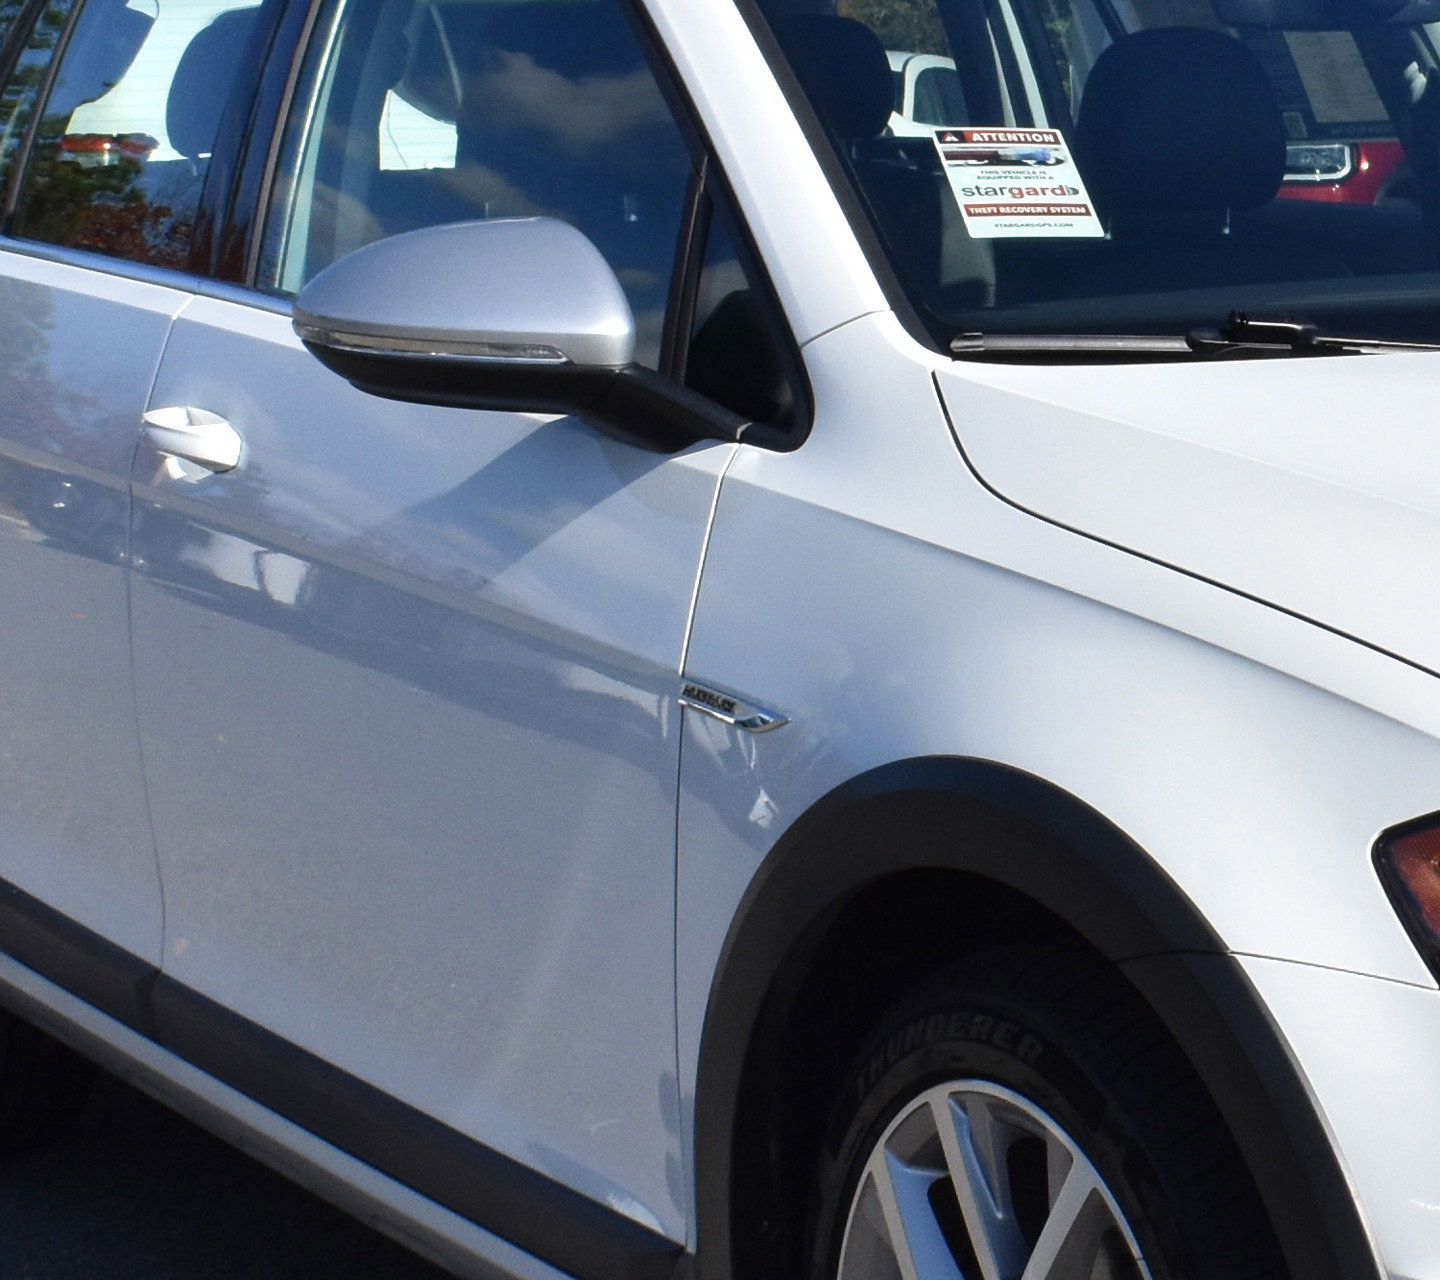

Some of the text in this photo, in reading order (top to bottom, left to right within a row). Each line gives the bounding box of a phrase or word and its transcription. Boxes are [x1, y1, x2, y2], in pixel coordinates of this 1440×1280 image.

[972, 132, 1055, 143] ATTENTION
[961, 185, 1068, 199] stargard
[999, 206, 1049, 214] RECOVERY
[1049, 206, 1087, 214] SYSTEM
